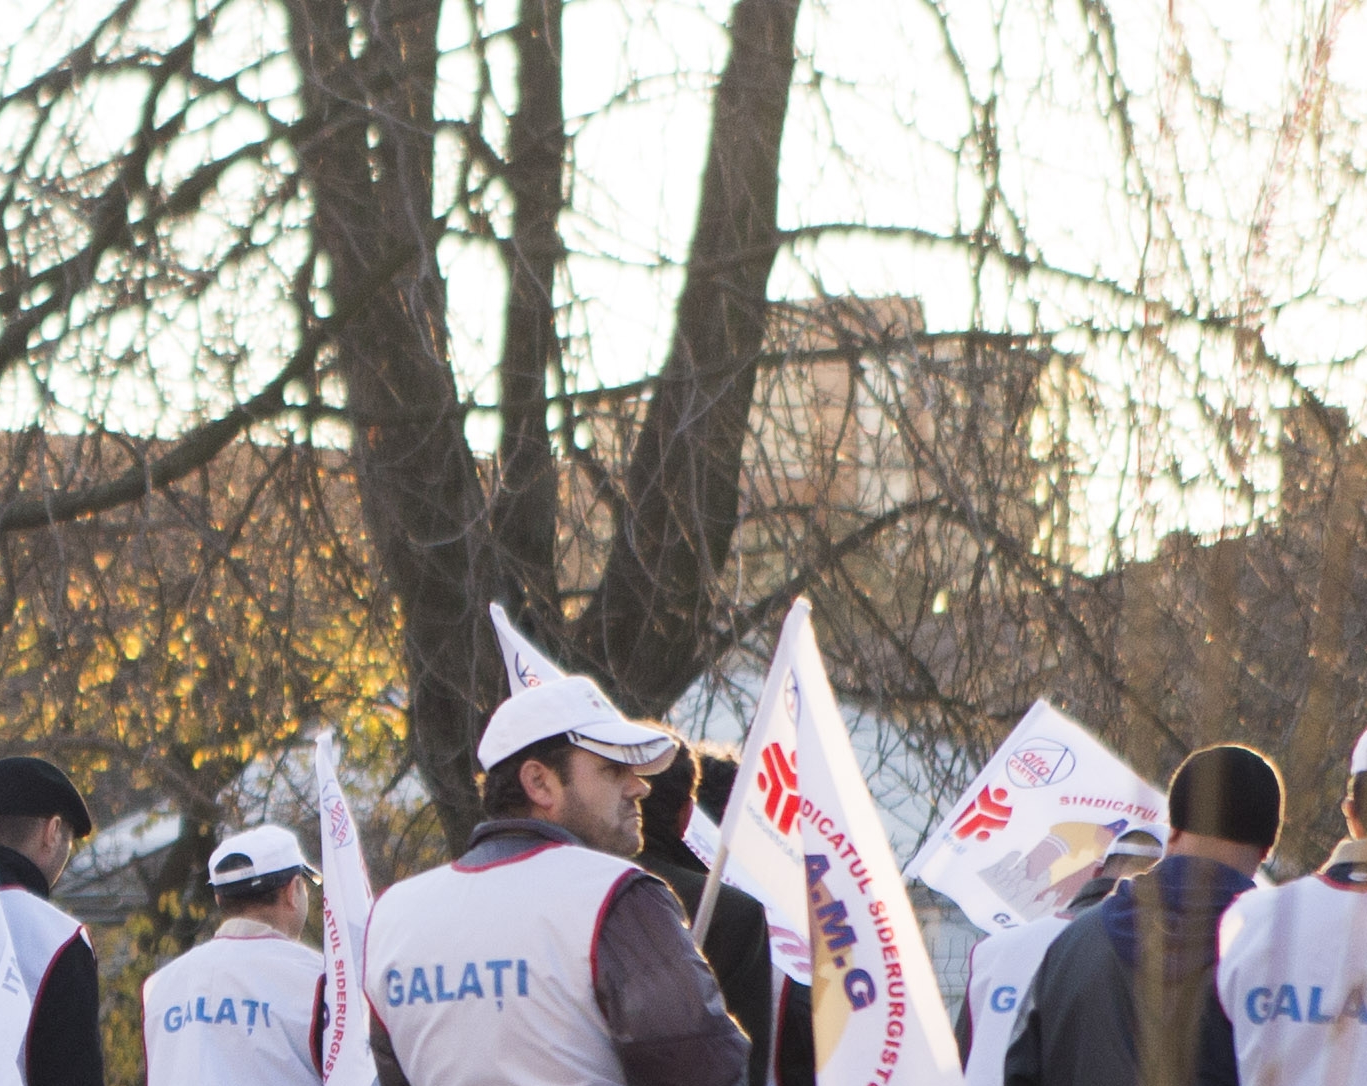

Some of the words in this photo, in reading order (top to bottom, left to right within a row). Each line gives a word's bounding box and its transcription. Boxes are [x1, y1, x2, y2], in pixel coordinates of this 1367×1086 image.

[1008, 758, 1040, 787] CARTEL
[804, 854, 878, 1012] A.M.G
[386, 958, 529, 1013] GALAȚI
[163, 996, 271, 1037] GALAȚI
